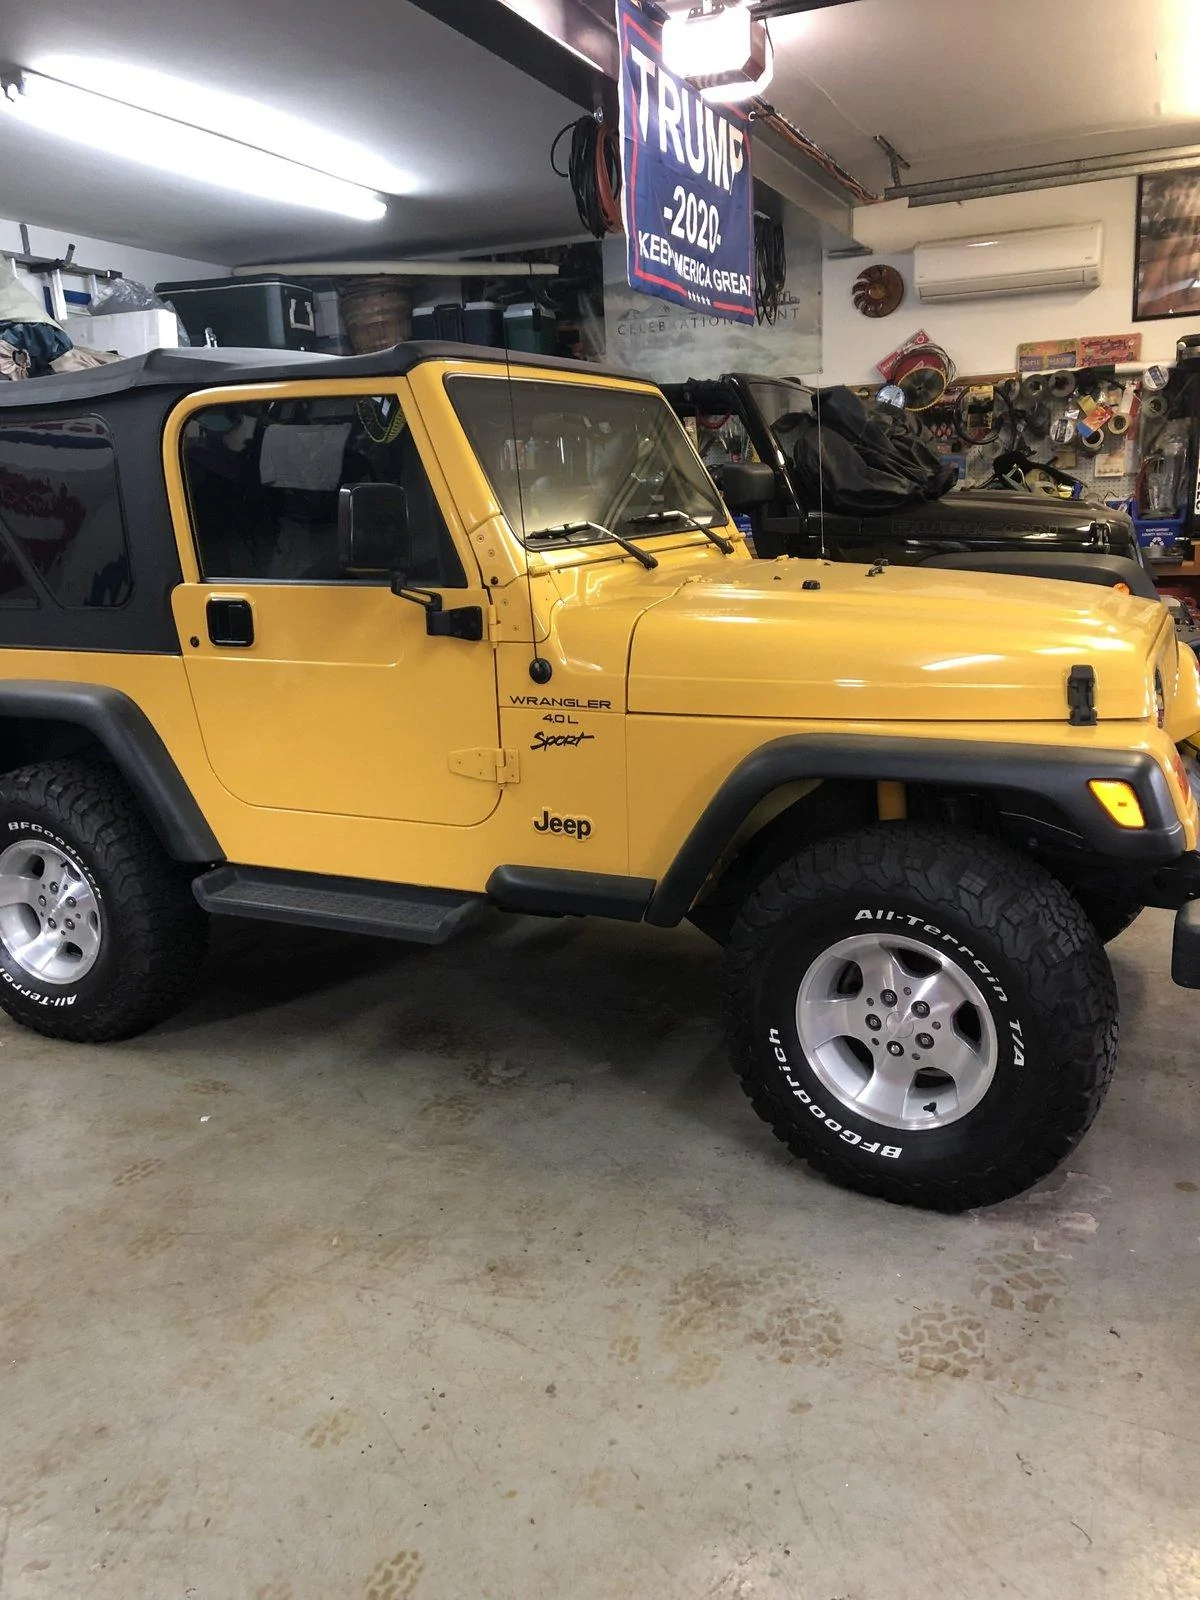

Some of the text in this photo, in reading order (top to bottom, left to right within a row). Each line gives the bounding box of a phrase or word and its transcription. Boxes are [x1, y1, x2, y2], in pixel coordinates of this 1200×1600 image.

[630, 44, 744, 195] TRUMP
[638, 230, 673, 266] KEEP
[712, 268, 751, 297] GREAT
[509, 695, 612, 709] WRANGLER
[530, 731, 595, 751] Sport
[7, 821, 102, 900] BFGoodrich
[533, 810, 592, 839] Jeep
[854, 908, 1025, 1067] All-Terrain T/A
[768, 1028, 903, 1160] BFGoodrich
